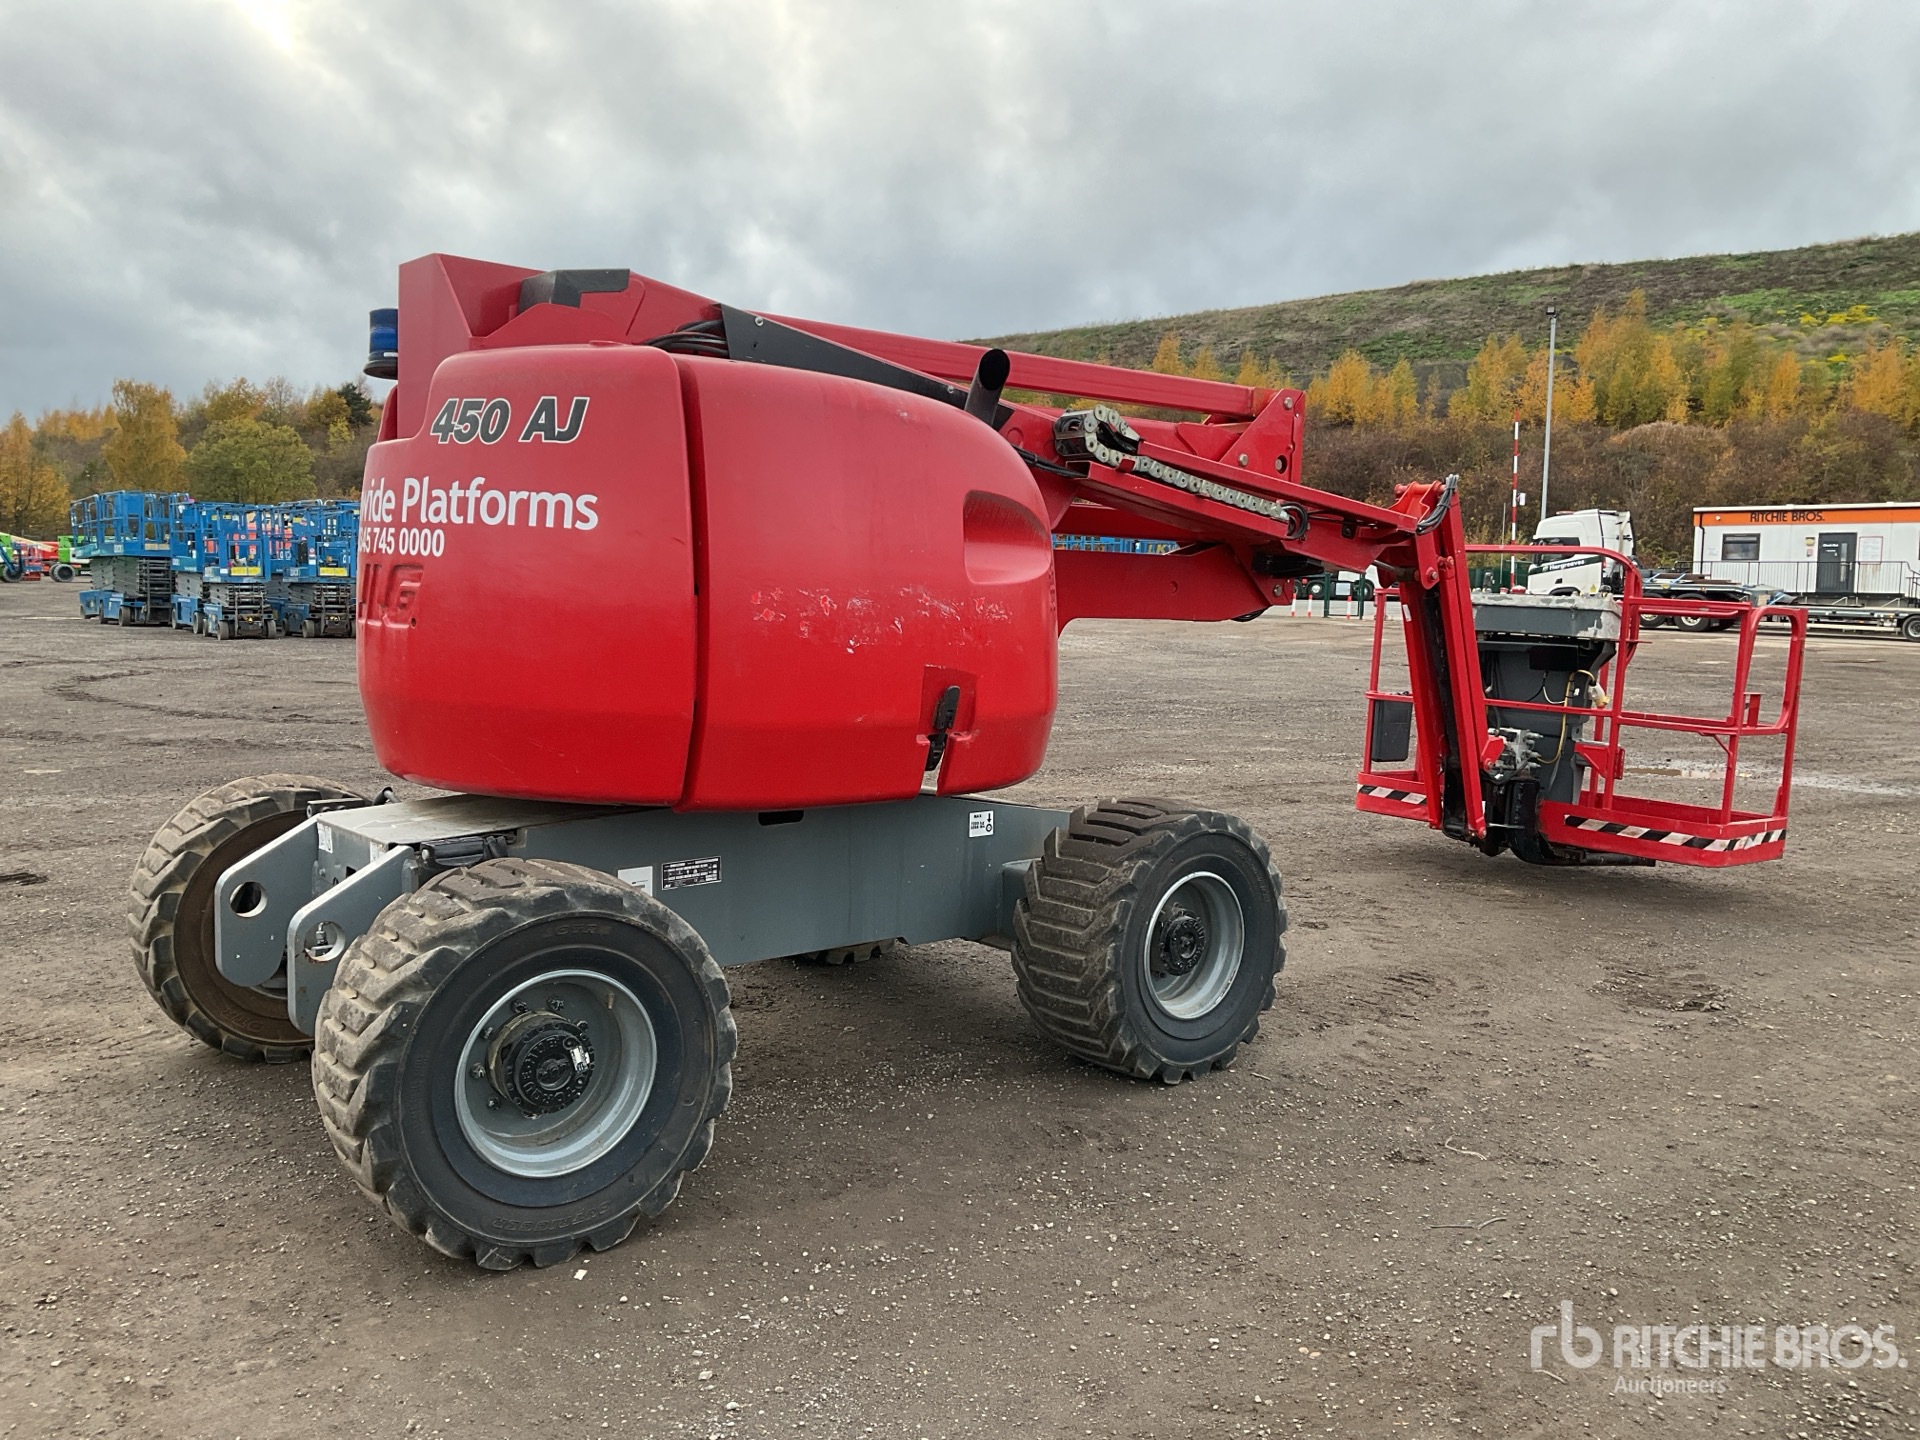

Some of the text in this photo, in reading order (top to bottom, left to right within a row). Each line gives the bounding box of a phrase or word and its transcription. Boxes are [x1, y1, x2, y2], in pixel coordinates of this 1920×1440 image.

[430, 396, 590, 445] 450 AJ
[401, 476, 599, 530] Platforms
[1750, 510, 1826, 523] RITCHIE BROS.
[373, 527, 396, 555] 745
[399, 528, 445, 557] 0000
